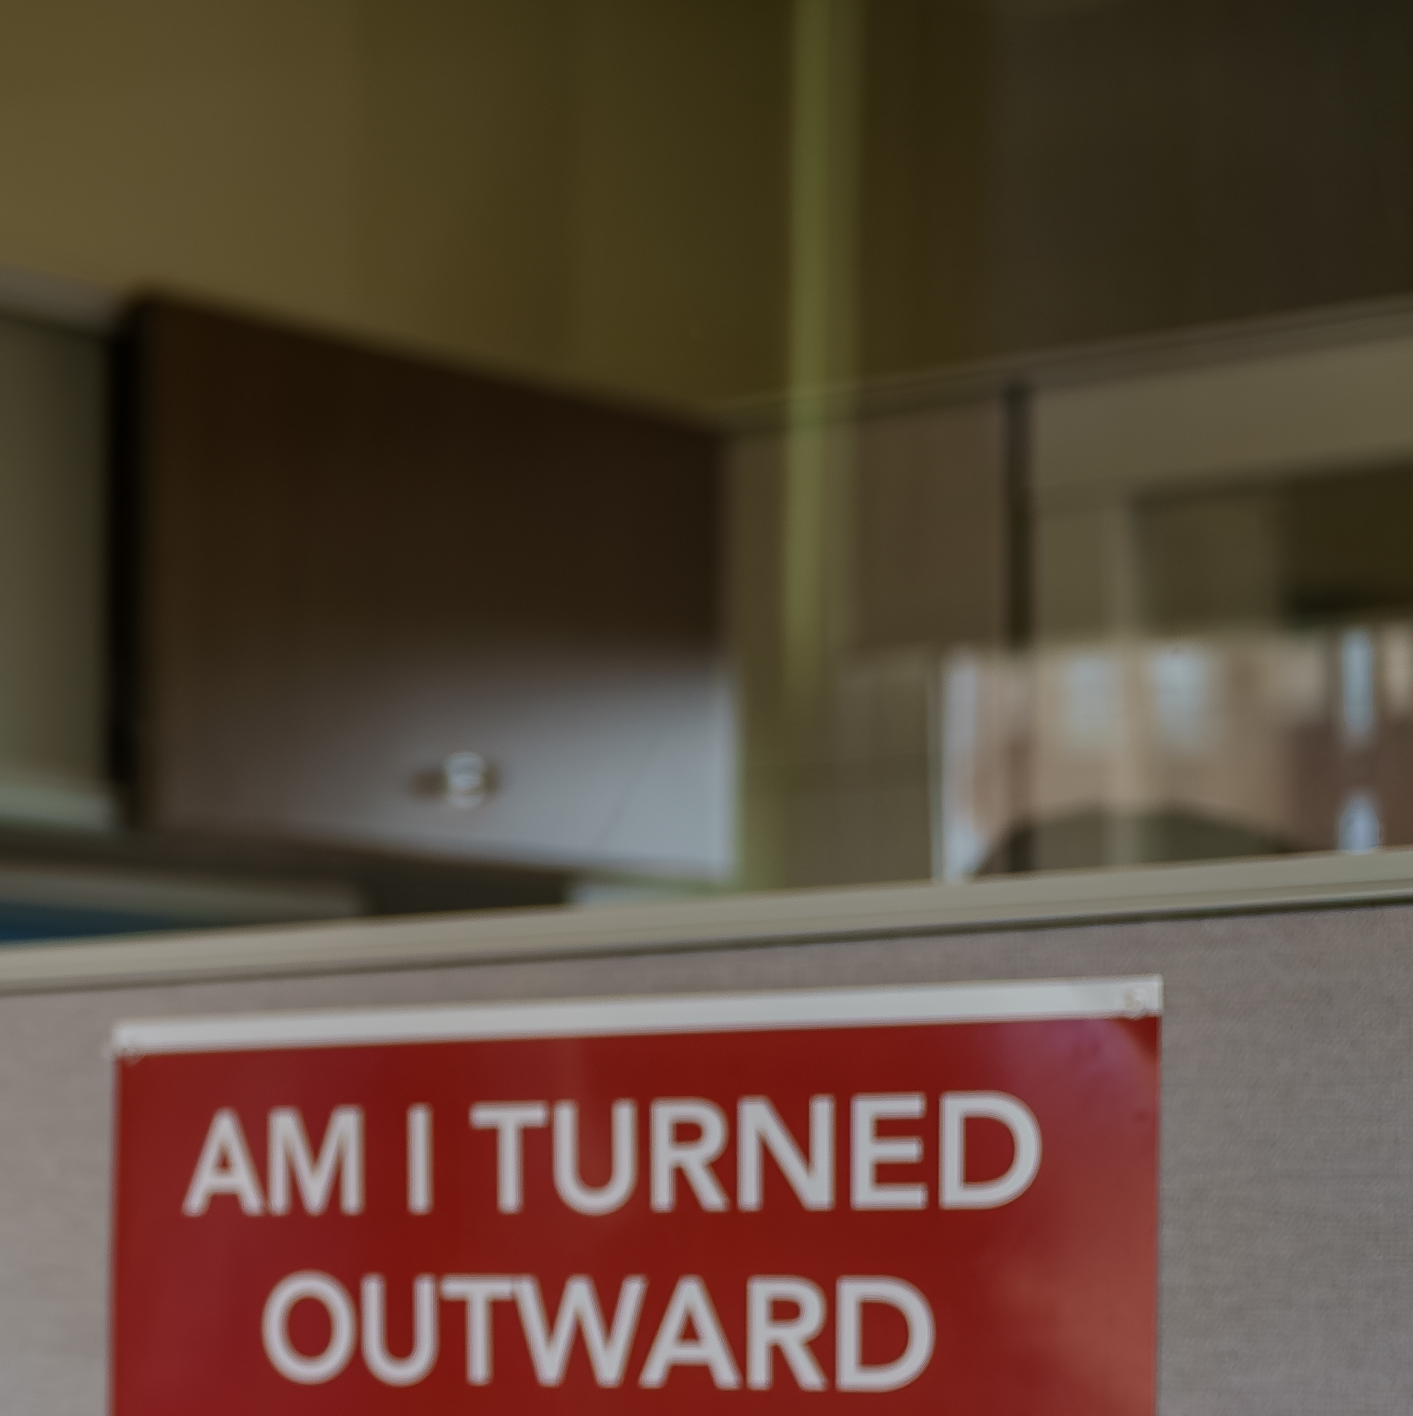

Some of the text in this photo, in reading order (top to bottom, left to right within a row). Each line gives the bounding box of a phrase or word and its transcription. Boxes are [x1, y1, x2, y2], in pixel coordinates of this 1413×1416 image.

[182, 1090, 1043, 1216] AM I TURNED
[261, 1270, 936, 1393] OUTWARD
